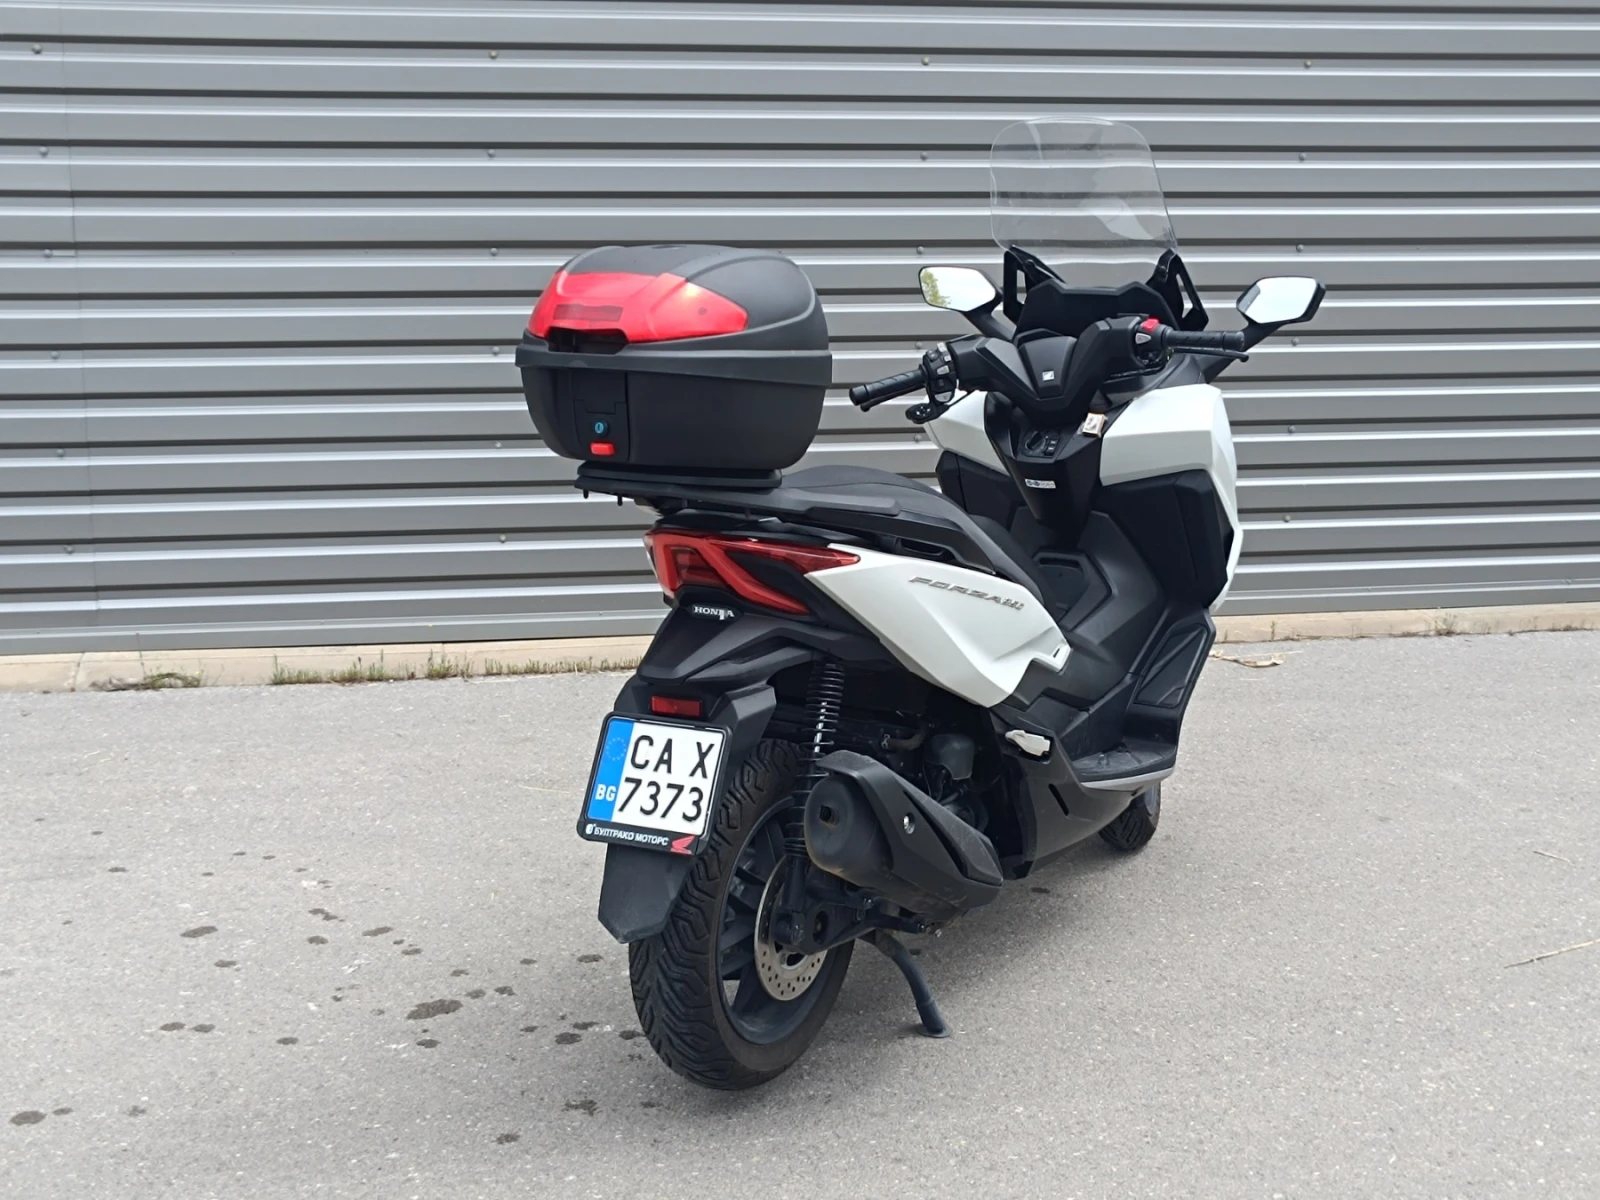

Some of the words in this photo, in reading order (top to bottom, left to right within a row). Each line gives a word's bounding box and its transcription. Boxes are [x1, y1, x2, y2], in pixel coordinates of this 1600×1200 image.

[908, 576, 1001, 604] FORZA
[630, 734, 673, 774] CA
[689, 741, 715, 779] X
[595, 783, 617, 801] BG
[617, 777, 704, 822] 7373
[594, 827, 634, 840] БУЛТРАКО
[634, 832, 669, 846] МОТОРС
